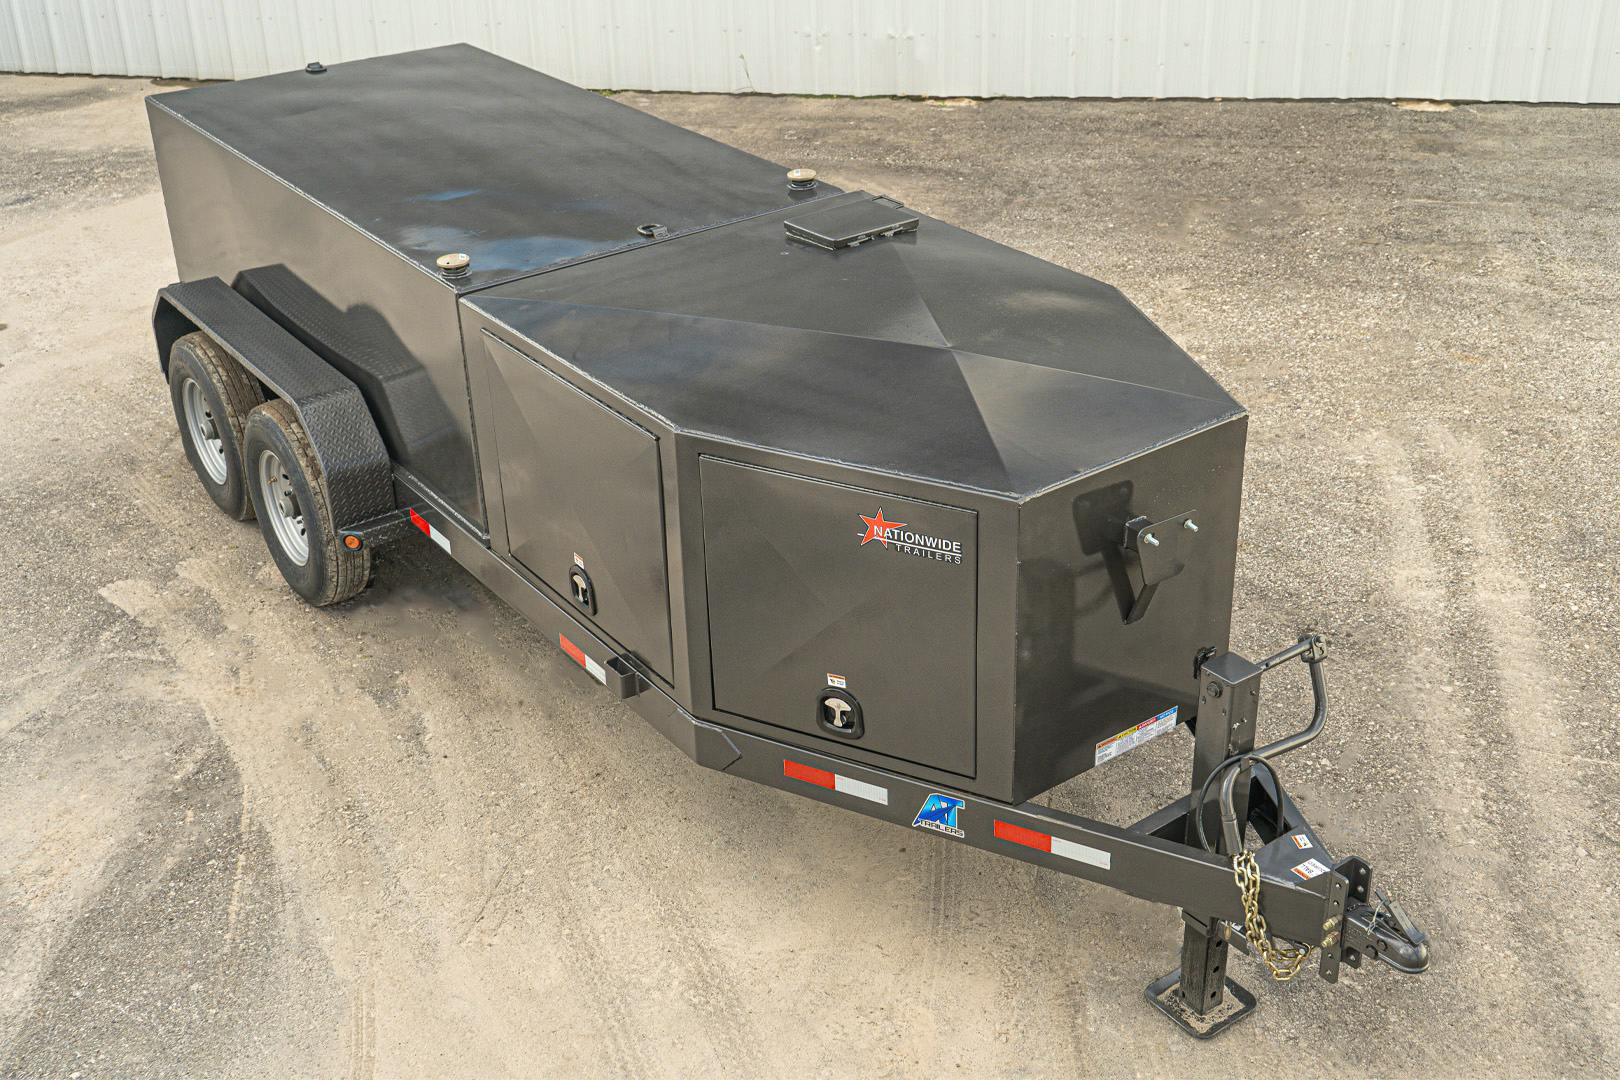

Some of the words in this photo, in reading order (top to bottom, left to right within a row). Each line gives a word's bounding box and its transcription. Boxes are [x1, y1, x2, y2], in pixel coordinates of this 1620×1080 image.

[873, 525, 961, 553] NATIONWIDE
[895, 544, 961, 565] TRAILERS
[920, 820, 964, 837] TRAILERS
